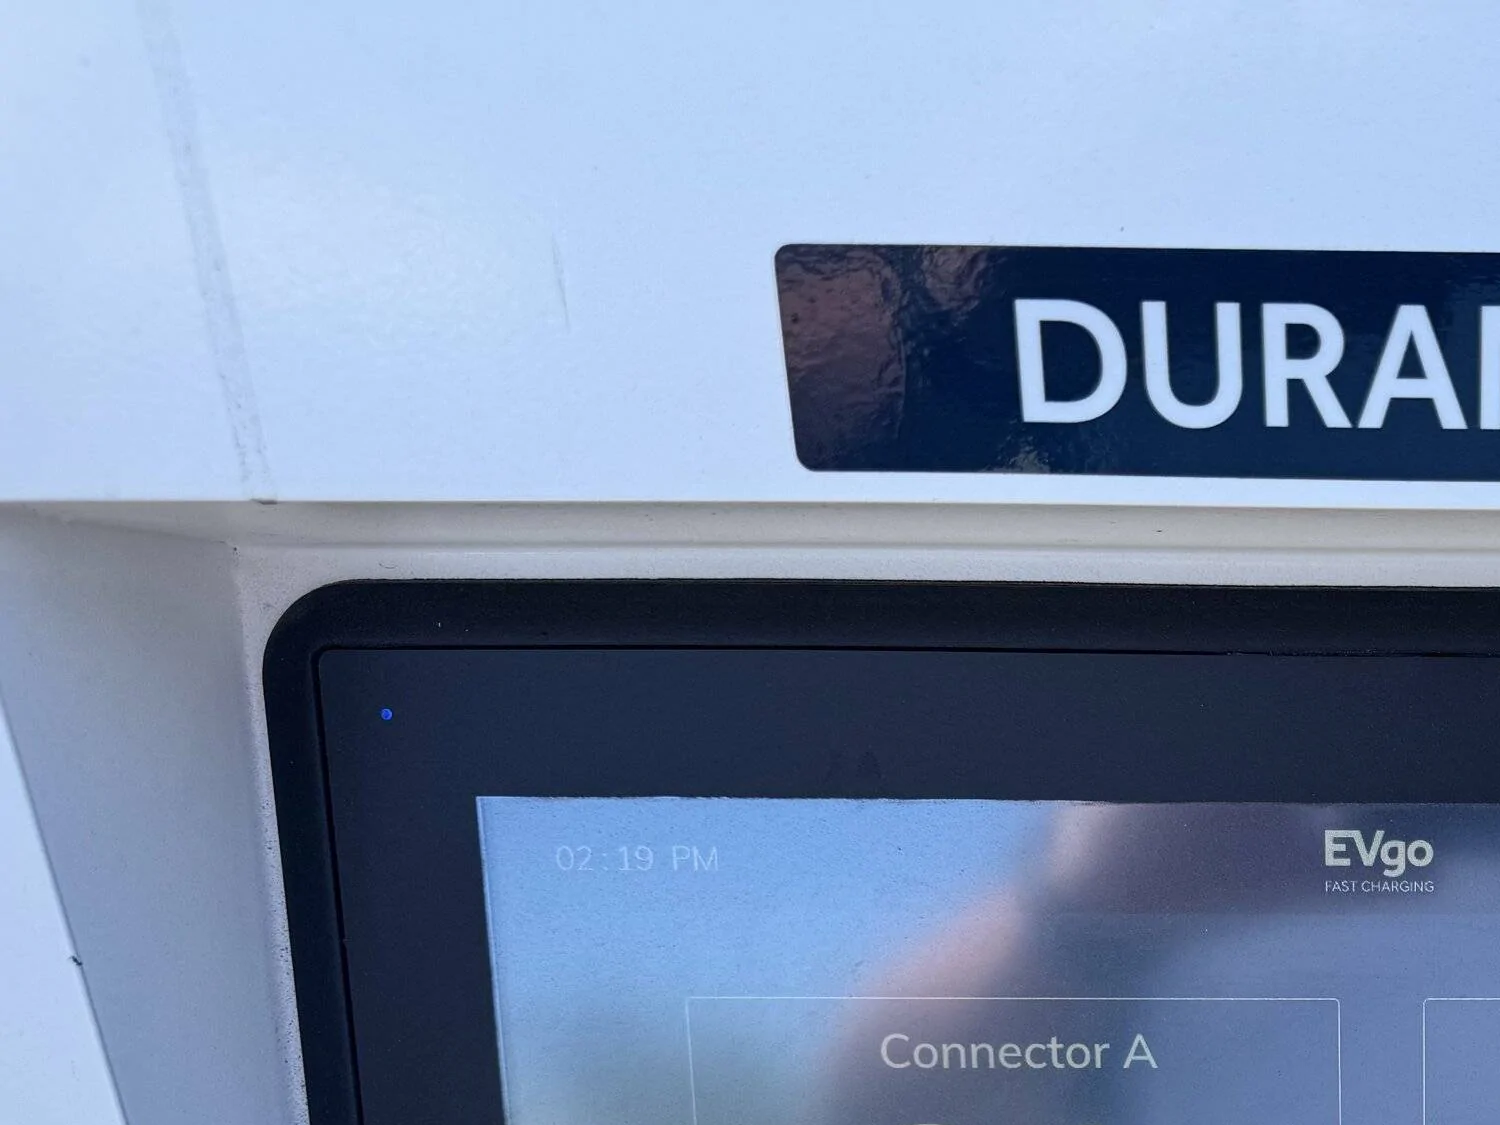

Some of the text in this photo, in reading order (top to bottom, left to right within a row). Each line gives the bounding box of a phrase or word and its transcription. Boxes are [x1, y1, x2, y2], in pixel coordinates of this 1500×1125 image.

[672, 845, 719, 871] PM
[1324, 829, 1434, 878] EVgo
[1325, 880, 1435, 893] FAST CHARGING
[879, 1032, 1159, 1071] Connector A
